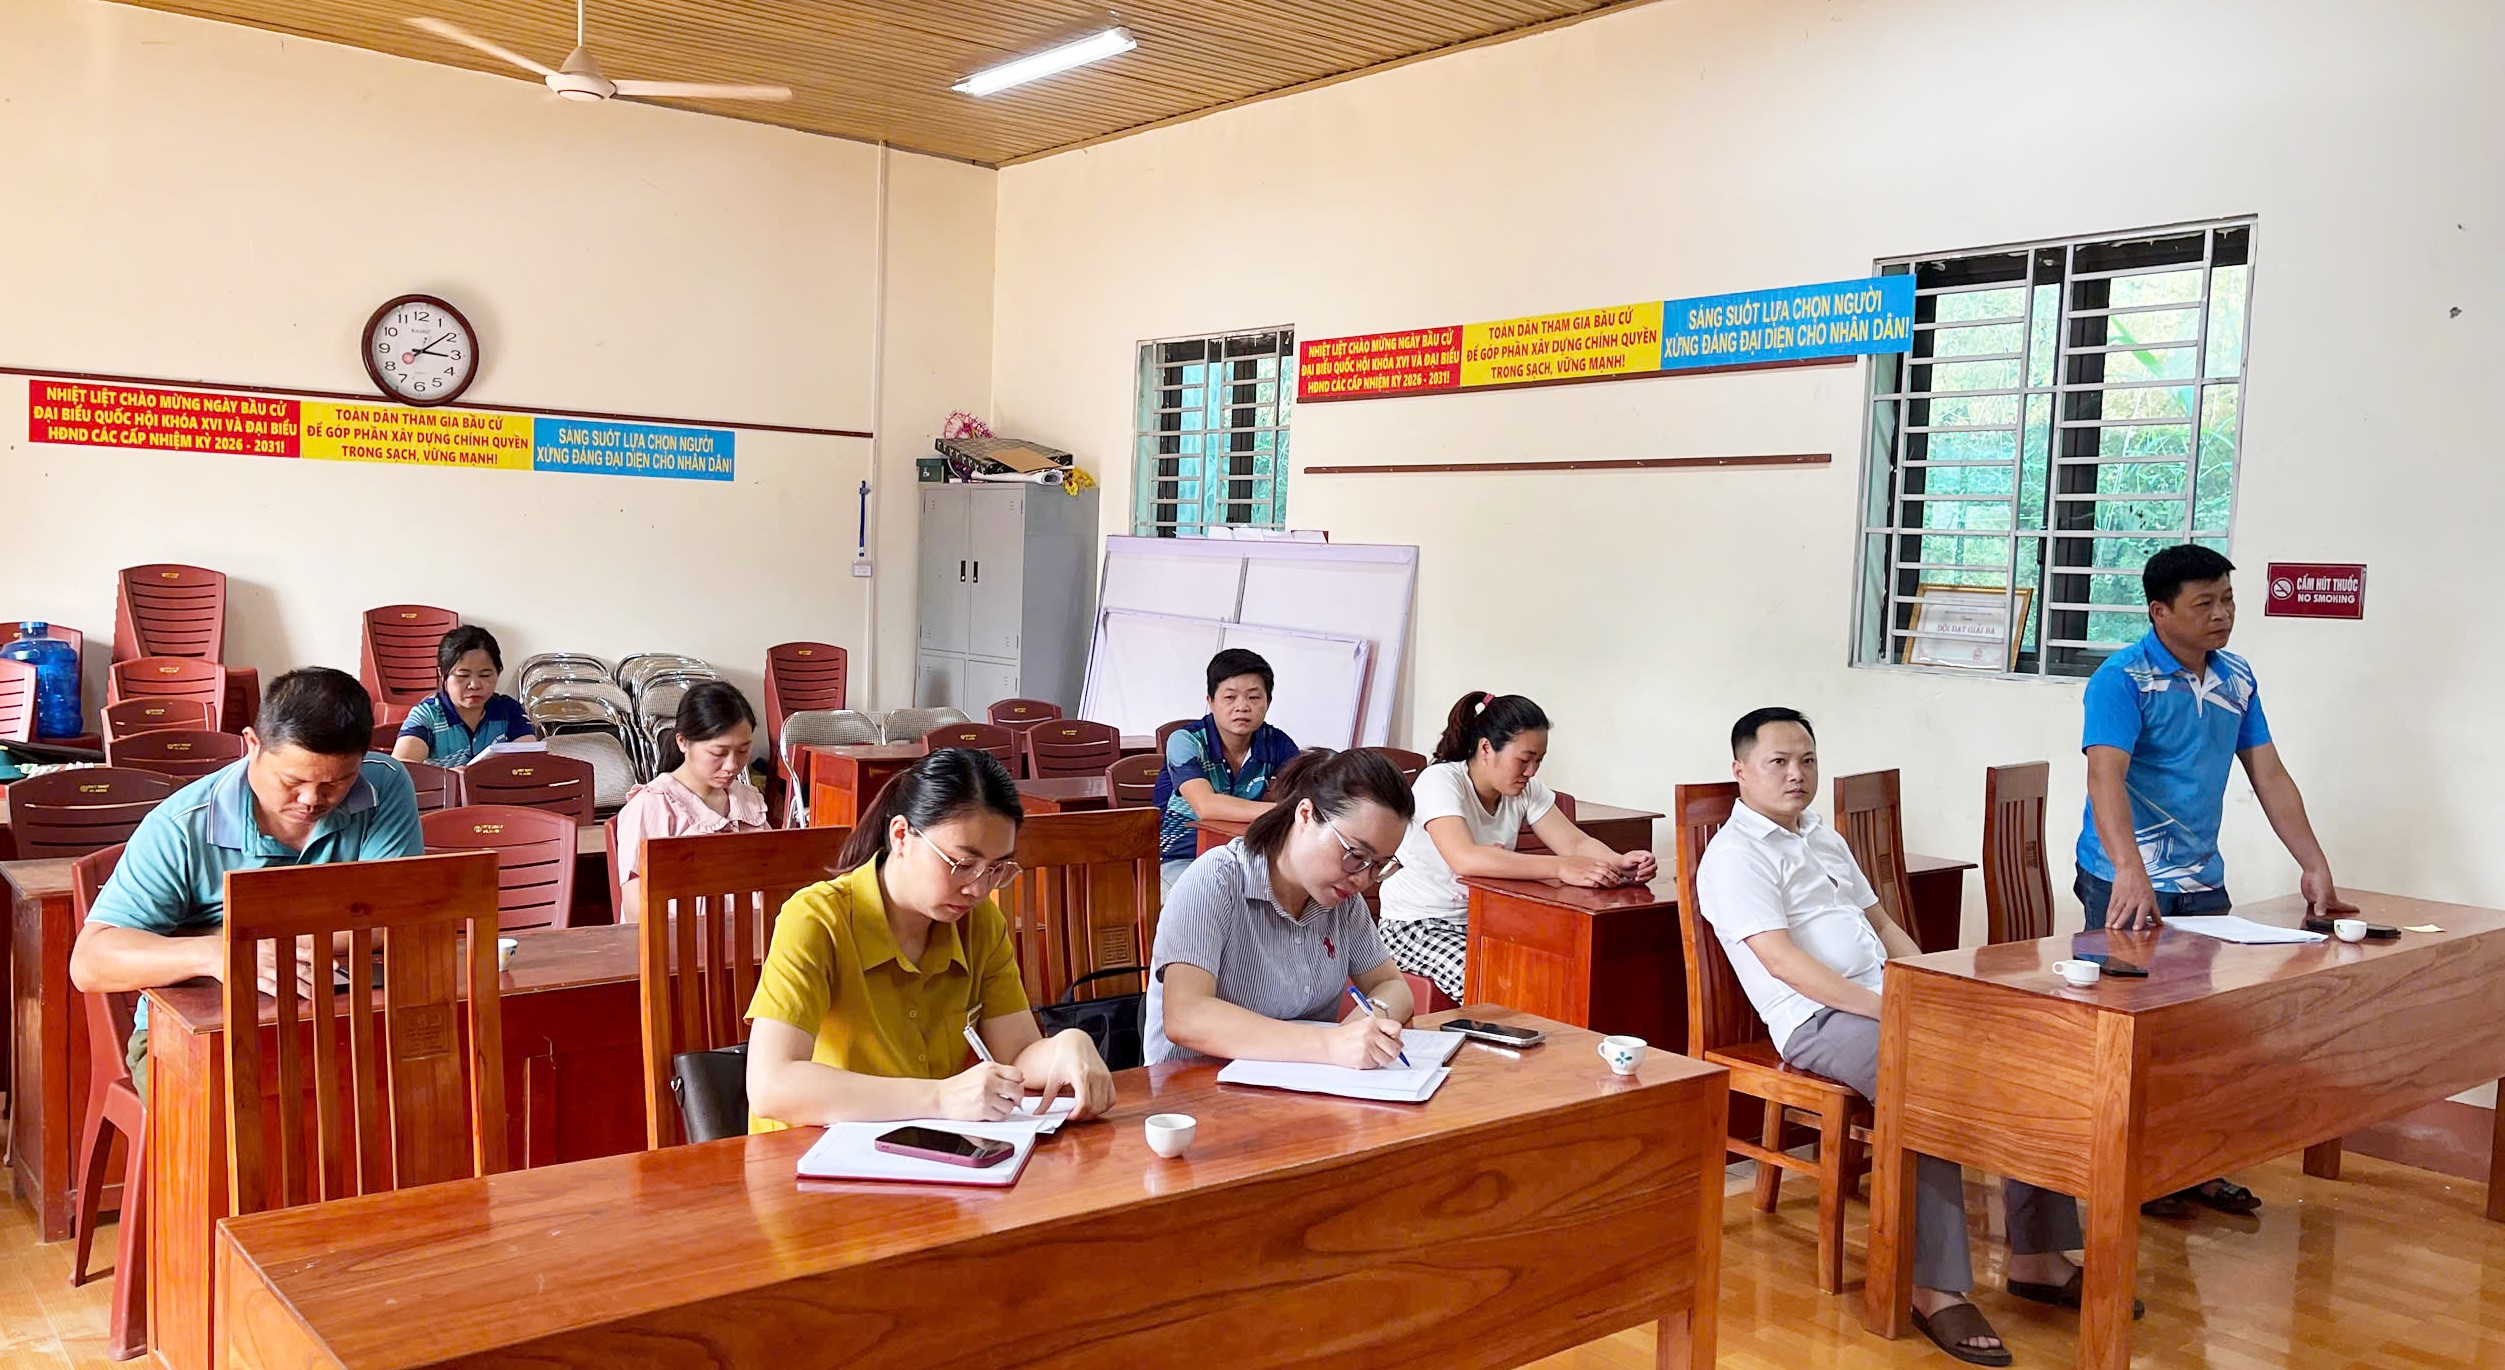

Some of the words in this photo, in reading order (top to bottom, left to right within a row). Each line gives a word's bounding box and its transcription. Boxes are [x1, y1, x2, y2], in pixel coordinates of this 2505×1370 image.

[414, 311, 430, 322] 12
[1689, 304, 1723, 330] SÁNG
[1762, 300, 1790, 327] LỰA
[1792, 295, 1831, 323] CHỌN
[1834, 285, 1882, 315] NGƯỜI
[398, 314, 408, 324] 11
[438, 318, 442, 327] 1
[1489, 322, 1515, 339] TOÀN
[1517, 319, 1538, 336] DÂN
[1541, 318, 1570, 334] THAM
[1573, 316, 1591, 330] GIA
[1594, 309, 1615, 328] BẦU
[1618, 306, 1634, 325] CỬ
[384, 327, 398, 337] 10
[446, 332, 457, 343] 2
[1664, 333, 1699, 358] XỨNG
[1701, 328, 1737, 355] ĐÁNG
[1740, 328, 1762, 356] ĐẠI
[1764, 325, 1794, 354] DIỆN
[1797, 323, 1827, 346] CHO
[1830, 315, 1869, 343] NHÂN
[1873, 312, 1910, 341] DÂN!
[379, 343, 391, 353] 9
[1308, 341, 1331, 359] NHIỆT
[1332, 340, 1347, 358] LIỆT
[1348, 337, 1370, 354] CHÀO
[1371, 335, 1397, 352] MỪNG
[1398, 333, 1420, 349] NGÀY
[1422, 330, 1440, 347] BẦU
[1441, 328, 1454, 345] CỬ
[1480, 344, 1499, 360] GÓP
[1502, 340, 1529, 358] PHẦN
[1531, 338, 1550, 355] XÂY
[1552, 337, 1582, 356] DỰNG
[1585, 332, 1618, 350] CHÍNH
[1621, 326, 1657, 347] QUYỀN
[450, 350, 462, 360] 3
[1301, 363, 1314, 379] ĐẠI
[1334, 356, 1355, 375] QUỐC
[1356, 356, 1370, 374] HỘI
[1372, 354, 1394, 371] KHÓA
[1396, 355, 1410, 369] XVI
[1411, 351, 1423, 367] VÀ
[1424, 353, 1439, 369] ĐẠI
[384, 361, 396, 371] 8
[443, 366, 454, 376] 4
[1491, 365, 1523, 379] TRONG
[1526, 361, 1553, 379] SẠCH,
[1557, 356, 1586, 373] VỮNG
[1589, 354, 1625, 373] MẠNH!
[398, 374, 408, 383] 7
[414, 382, 426, 392] 6
[432, 377, 443, 387] 5
[1331, 376, 1346, 392] CÁC
[1347, 374, 1362, 391] CẤP
[1364, 373, 1390, 392] NHIỆM
[1391, 371, 1402, 388] KỲ
[1403, 373, 1422, 387] 2026
[1429, 370, 1450, 385] 2031!
[47, 385, 87, 406] NHIỆT
[90, 388, 117, 408] LIỆT
[119, 390, 157, 408] CHÀO
[160, 393, 201, 411] MỪNG
[204, 397, 238, 413] NGÀY
[241, 398, 267, 416] BẦU
[269, 401, 287, 417] CỬ
[33, 406, 58, 423] ĐẠI
[94, 407, 131, 425] QUỐC
[134, 410, 159, 430] HỘI
[161, 413, 199, 430] KHÓA
[201, 417, 223, 431] XVI
[225, 416, 243, 433] VÀ
[245, 421, 268, 437] ĐẠI
[336, 407, 370, 422] TOÀN
[373, 409, 399, 424] DÂN
[402, 414, 437, 427] THAM
[440, 416, 459, 428] GIA
[463, 414, 485, 429] BẦU
[488, 416, 504, 431] CỬ
[48, 426, 89, 442] HĐND
[91, 426, 118, 443] CÁC
[120, 427, 147, 445] CẤP
[149, 431, 192, 450] NHIỆM
[195, 432, 212, 449] KỲ
[214, 436, 243, 451] 2026
[254, 440, 285, 454] 2031!
[326, 424, 350, 438] GÓP
[354, 425, 388, 441] PHẦN
[392, 428, 413, 442] XÂY
[417, 431, 450, 446] DỰNG
[454, 433, 489, 447] CHÍNH
[492, 434, 529, 449] QUYỀN
[559, 425, 589, 445] SÁNG
[623, 432, 645, 451] LỰA
[680, 434, 714, 453] NGƯỜI
[342, 445, 383, 459] TRONG
[386, 448, 420, 463] SẠCH,
[423, 448, 456, 462] VỮNG
[460, 452, 498, 466] MẠNH!
[536, 442, 570, 464] XỨNG
[572, 445, 602, 466] ĐÁNG
[605, 450, 624, 470] ĐẠI
[653, 453, 675, 469] CHO
[678, 453, 706, 472] NHÂN
[708, 454, 732, 474] DÂN!
[2297, 573, 2315, 591] CẤM
[2316, 575, 2331, 591] HÚT
[2333, 574, 2359, 592] THUỐC
[2298, 593, 2311, 603] NO
[2313, 594, 2355, 604] SMOKING
